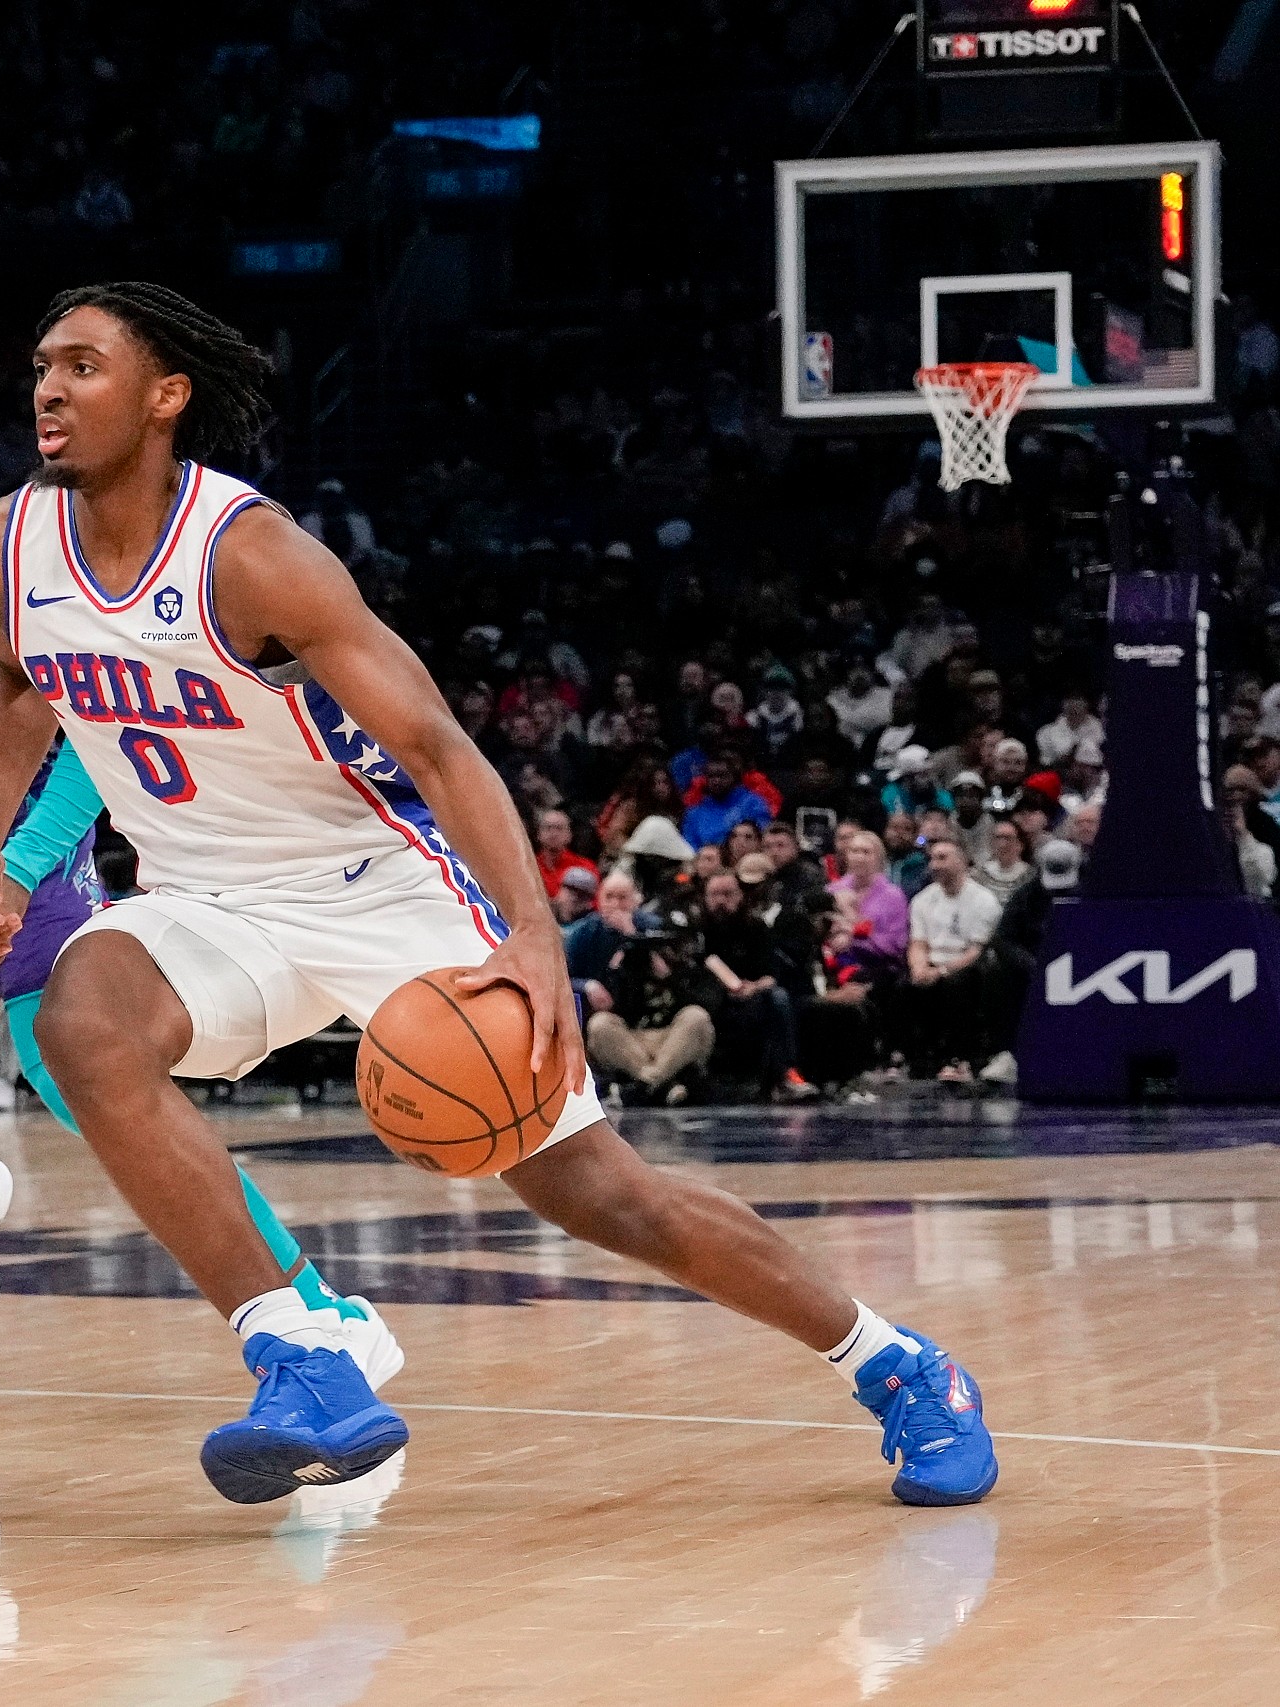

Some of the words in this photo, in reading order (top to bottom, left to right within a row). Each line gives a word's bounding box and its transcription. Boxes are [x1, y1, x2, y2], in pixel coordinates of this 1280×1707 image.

[977, 27, 1106, 58] TISSOT
[141, 632, 198, 642] crypto.com
[24, 653, 245, 730] PHILA
[119, 727, 198, 805] 0
